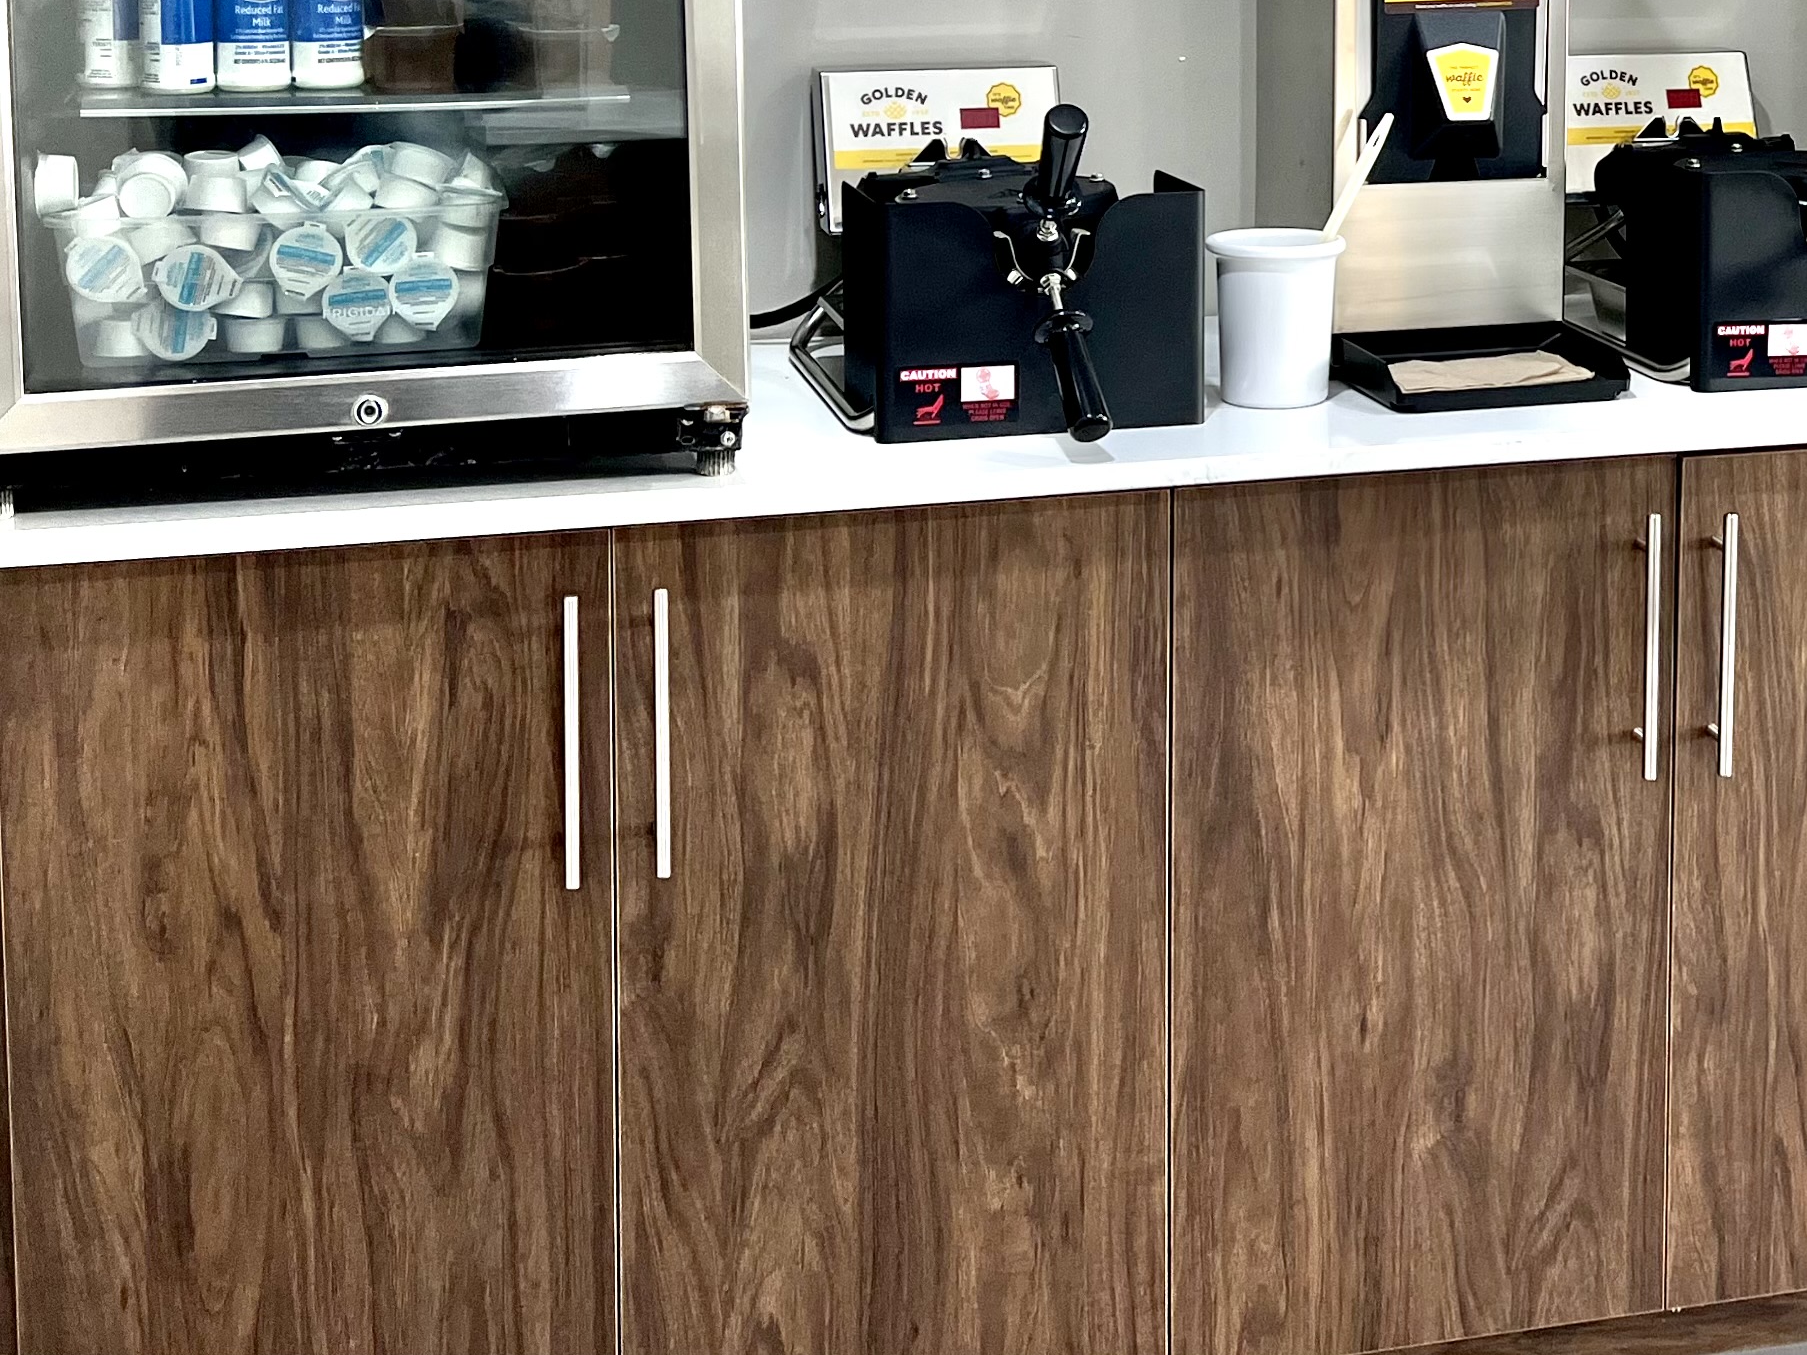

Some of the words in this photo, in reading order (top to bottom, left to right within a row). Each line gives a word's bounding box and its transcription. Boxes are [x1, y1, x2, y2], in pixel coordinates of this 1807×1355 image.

[235, 5, 272, 14] Reduced
[317, 3, 353, 14] Reduced
[252, 18, 271, 27] Milk
[335, 16, 352, 25] Milk
[1580, 69, 1639, 87] GOLDEN
[860, 87, 928, 105] GOLDEN
[1573, 101, 1654, 117] WAFFLES
[850, 120, 943, 138] WAFFLES
[322, 306, 400, 320] FRIGIDAI
[1717, 325, 1766, 335] CAUTION
[1729, 338, 1752, 347] HOT
[900, 368, 957, 381] CAUTION
[915, 384, 941, 393] HOT
